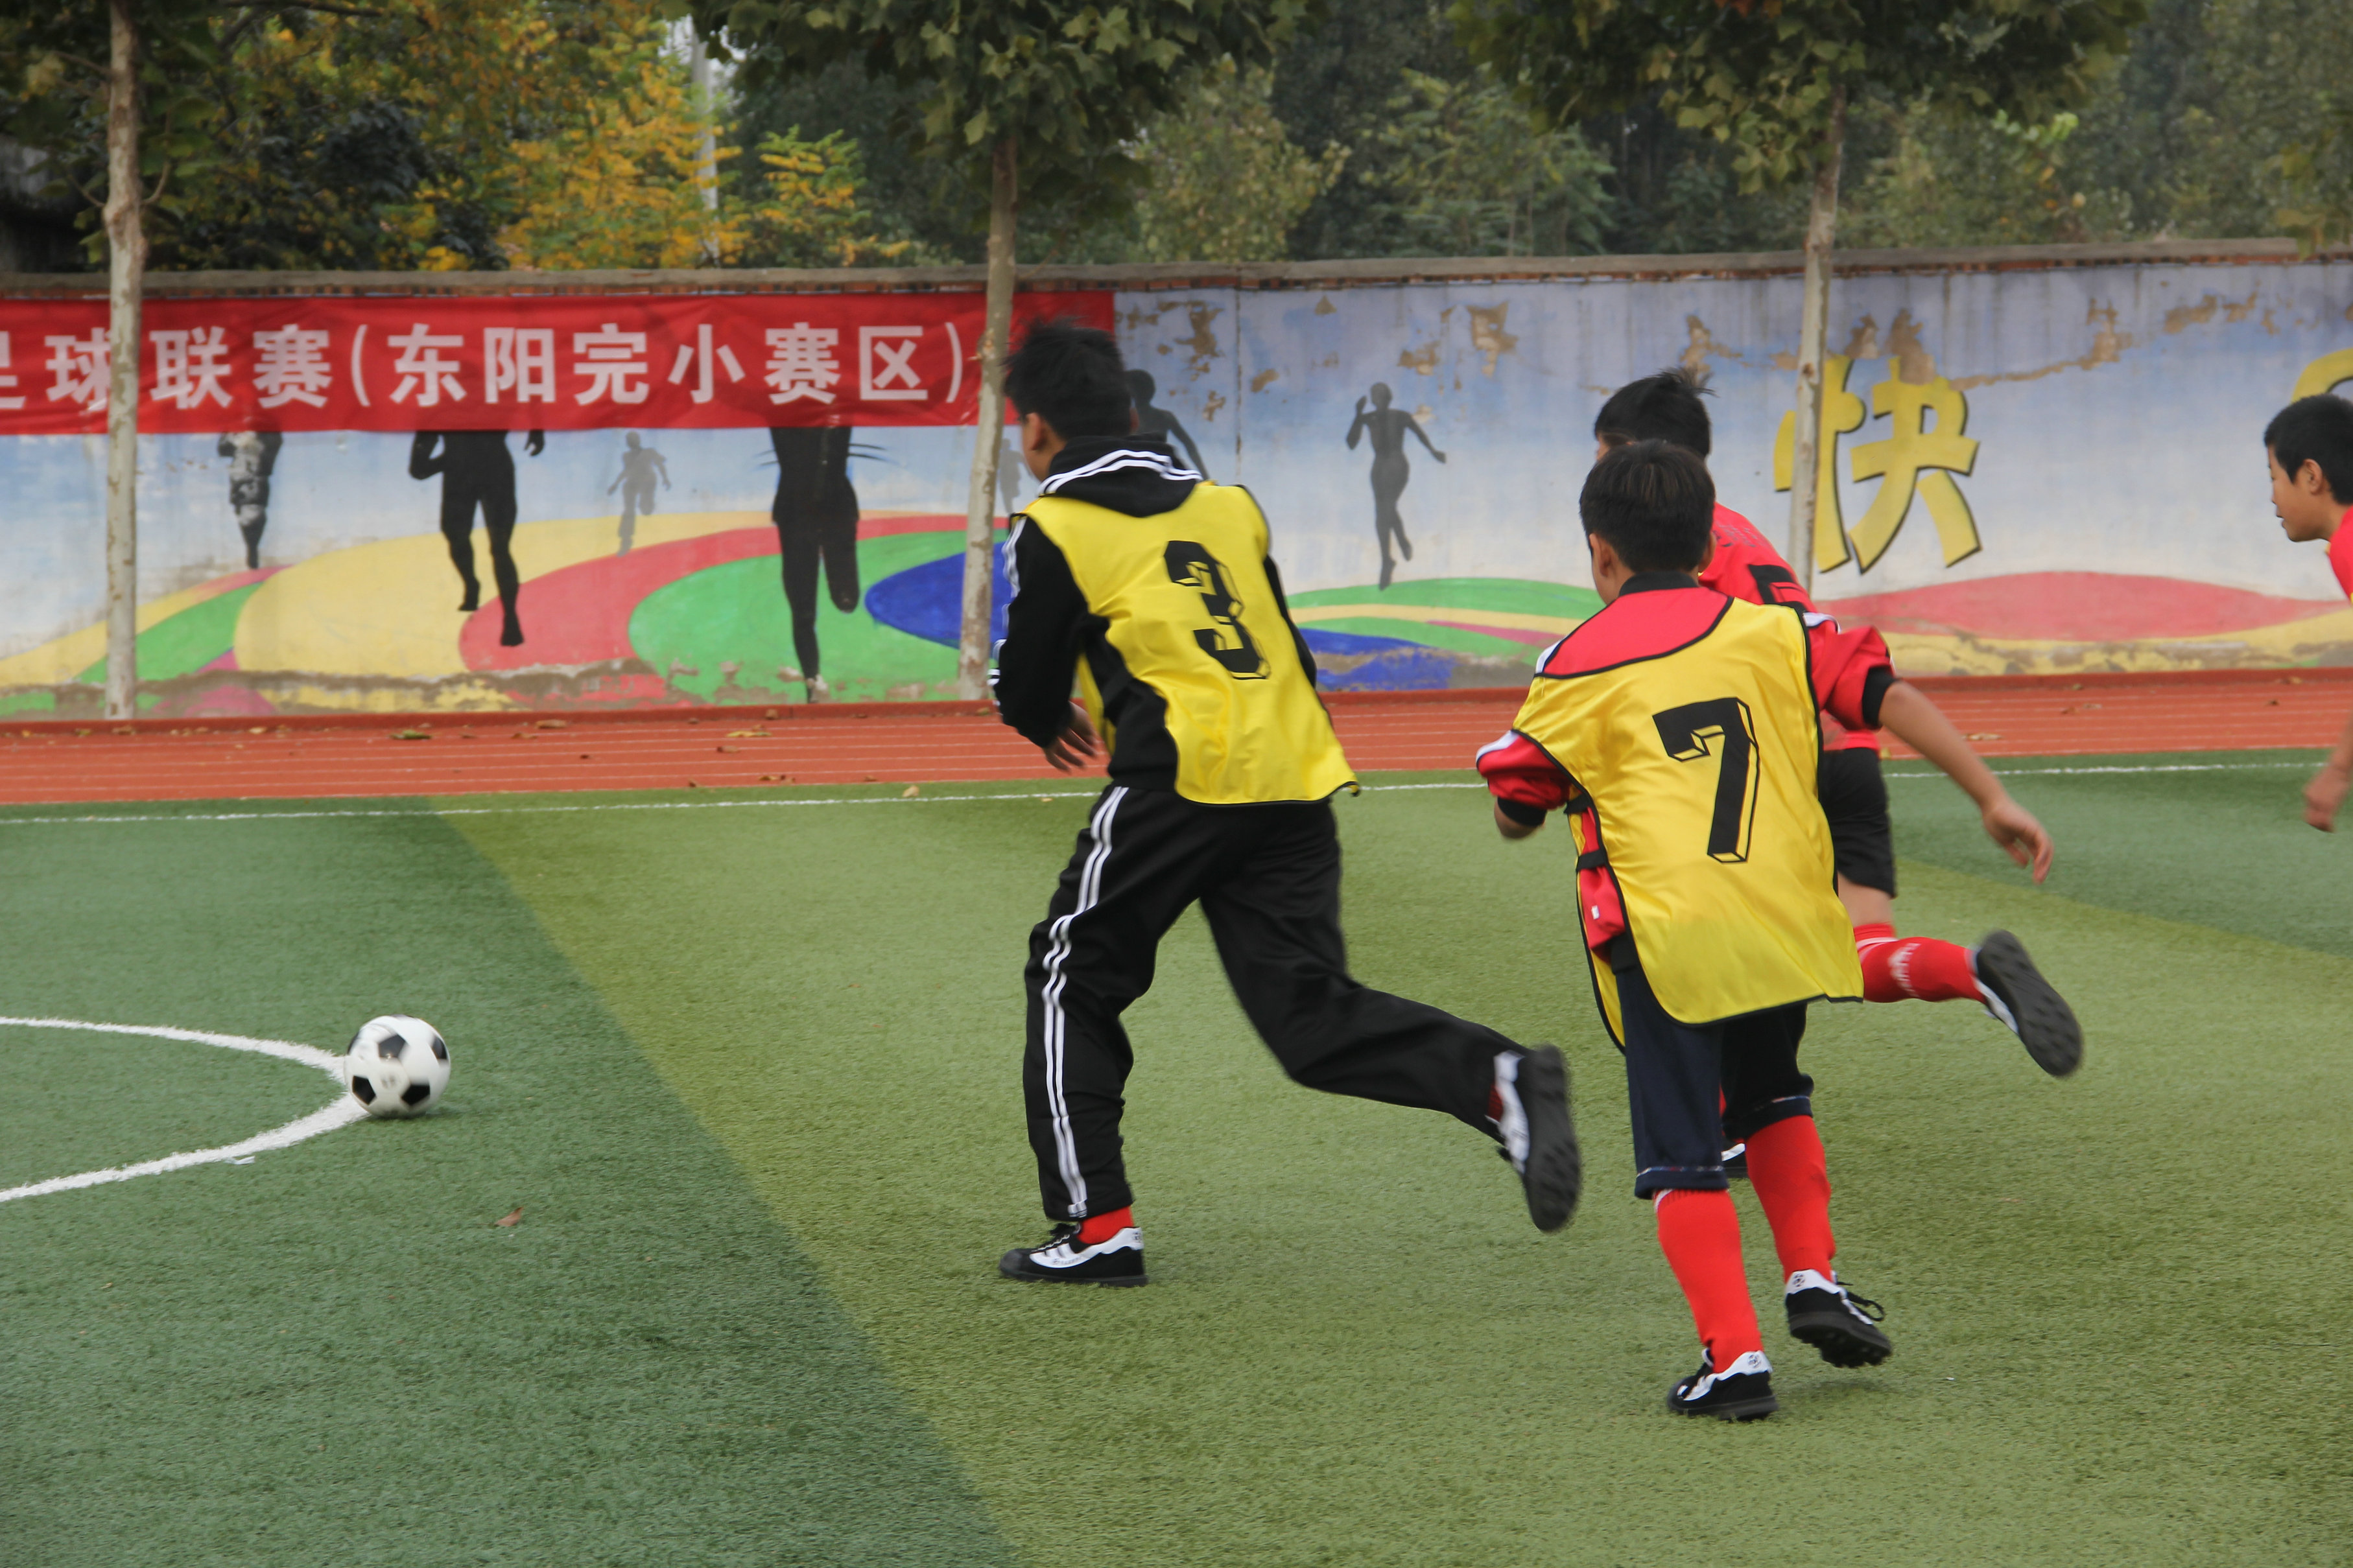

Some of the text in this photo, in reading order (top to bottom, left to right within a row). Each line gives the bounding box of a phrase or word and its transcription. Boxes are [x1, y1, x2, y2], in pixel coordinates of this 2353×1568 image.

[1773, 355, 1983, 575] 快
[1164, 540, 1270, 679] 3
[1652, 697, 1760, 863] 7
